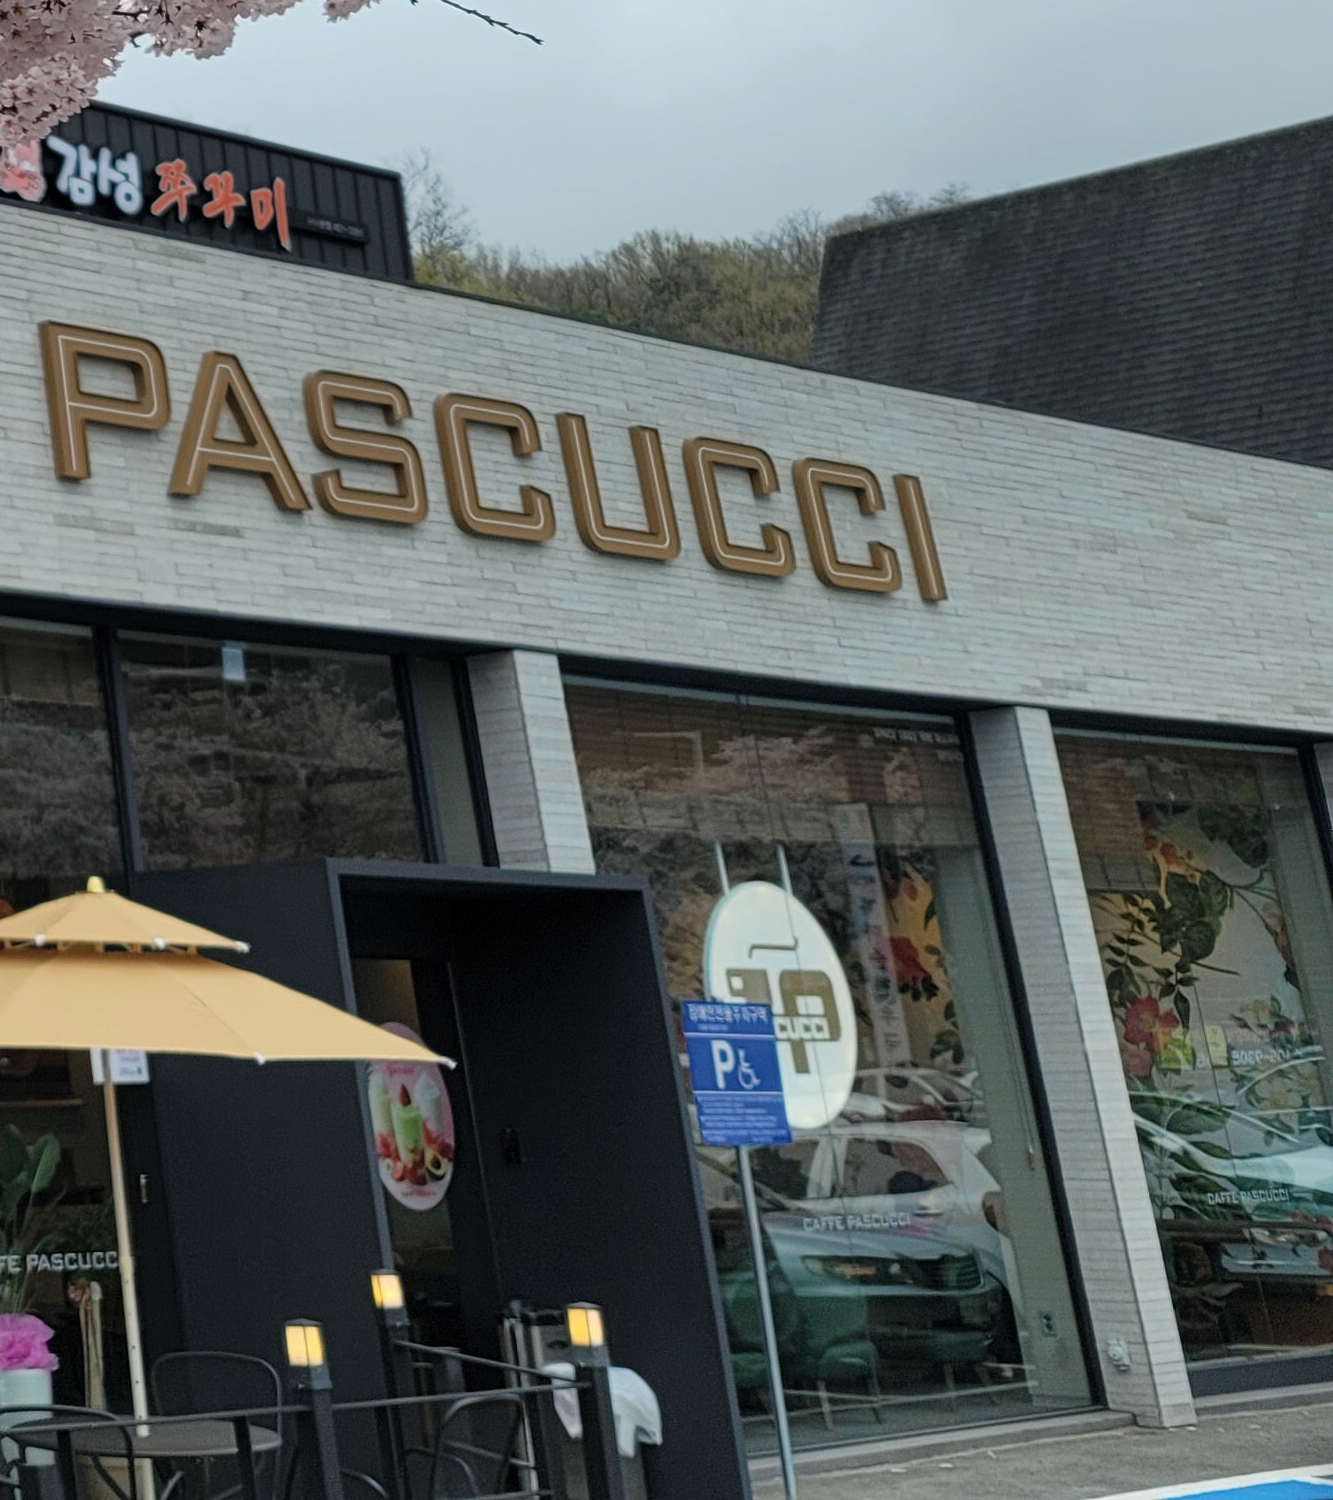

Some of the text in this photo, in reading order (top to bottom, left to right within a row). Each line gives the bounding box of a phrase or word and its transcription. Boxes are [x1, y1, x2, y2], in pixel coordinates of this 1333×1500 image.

[46, 134, 292, 252] 감성 쭈꾸미
[38, 320, 948, 603] PASCUCCI
[774, 1016, 831, 1040] CUCCI
[711, 1039, 735, 1090] P
[26, 1250, 120, 1273] PASCUCC
